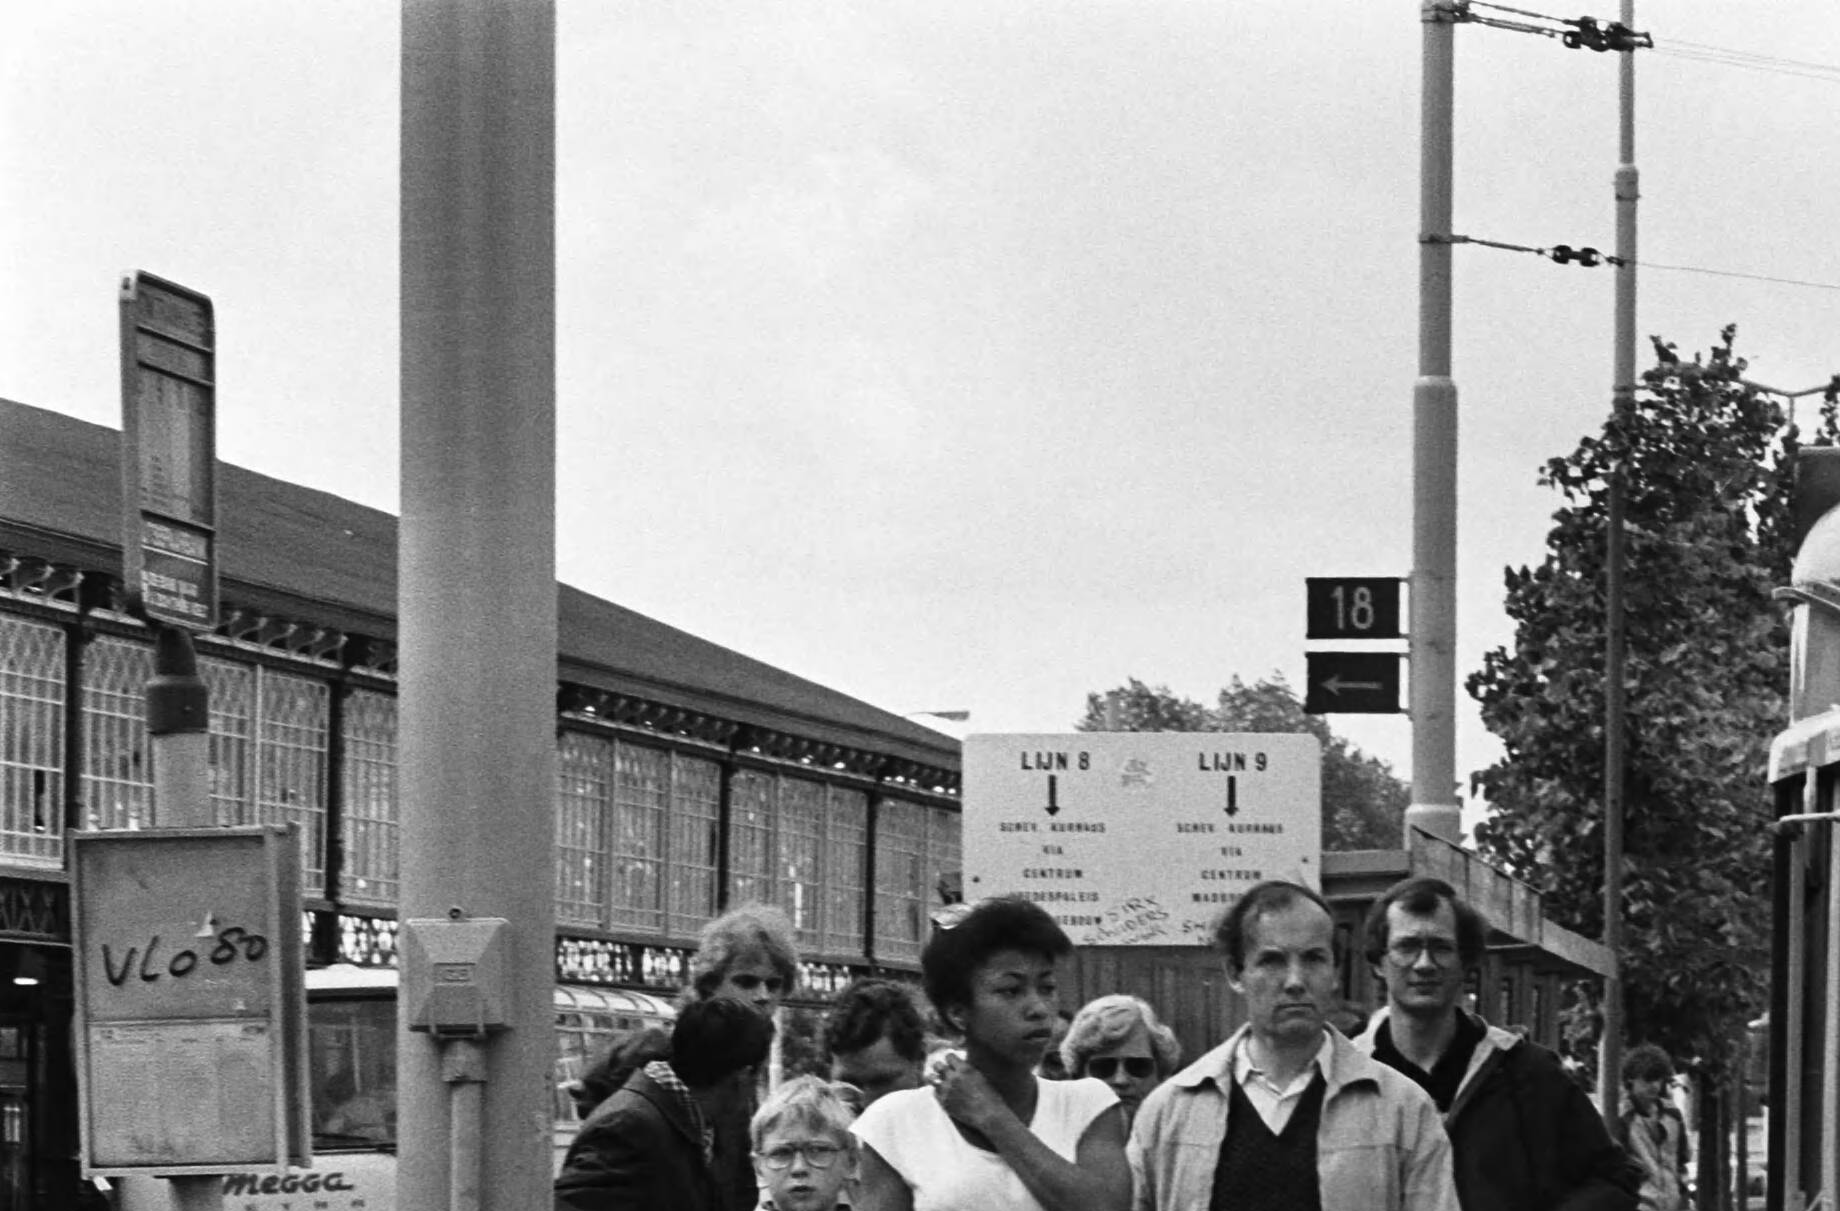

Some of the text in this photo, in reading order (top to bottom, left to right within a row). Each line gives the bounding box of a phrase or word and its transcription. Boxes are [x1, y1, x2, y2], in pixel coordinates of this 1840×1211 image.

[1329, 585, 1374, 630] 18
[1020, 751, 1091, 771] LIJN 8
[1198, 752, 1268, 772] LIJN 9
[1023, 868, 1083, 879] CENTRUM
[1201, 869, 1262, 880] CENTRUM
